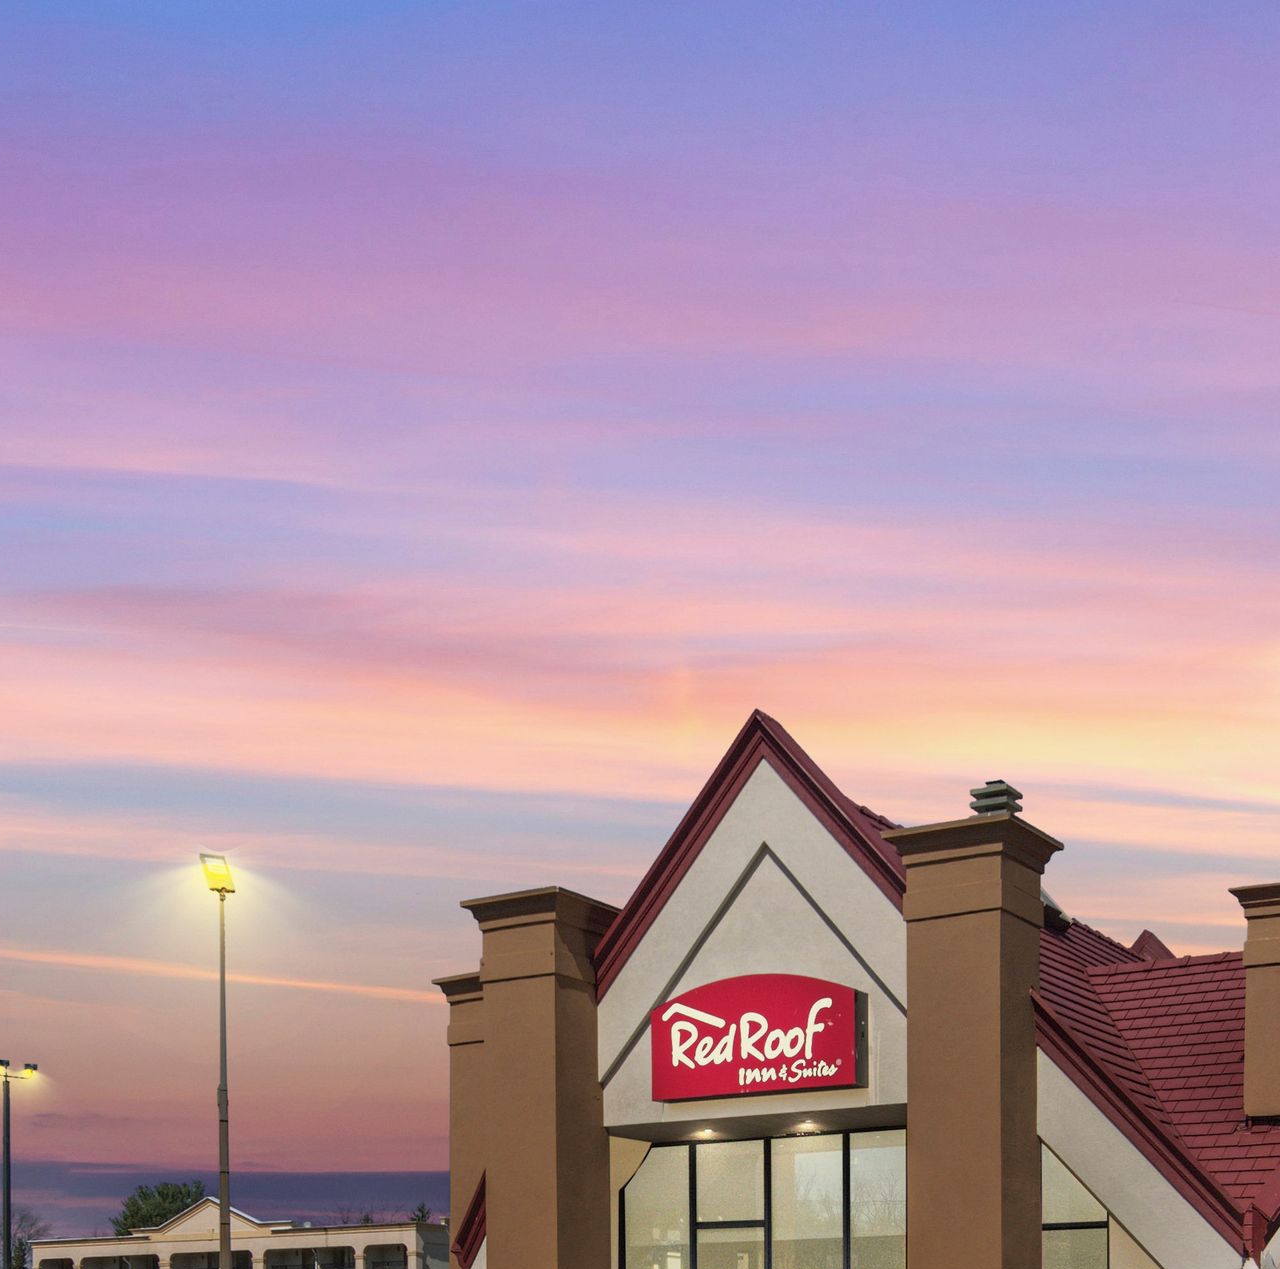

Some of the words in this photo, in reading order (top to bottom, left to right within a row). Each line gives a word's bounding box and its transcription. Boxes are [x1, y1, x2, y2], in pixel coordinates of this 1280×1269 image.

[671, 1020, 737, 1069] Red
[739, 997, 833, 1062] Roof
[738, 1066, 777, 1086] Inn
[778, 1063, 788, 1081] &
